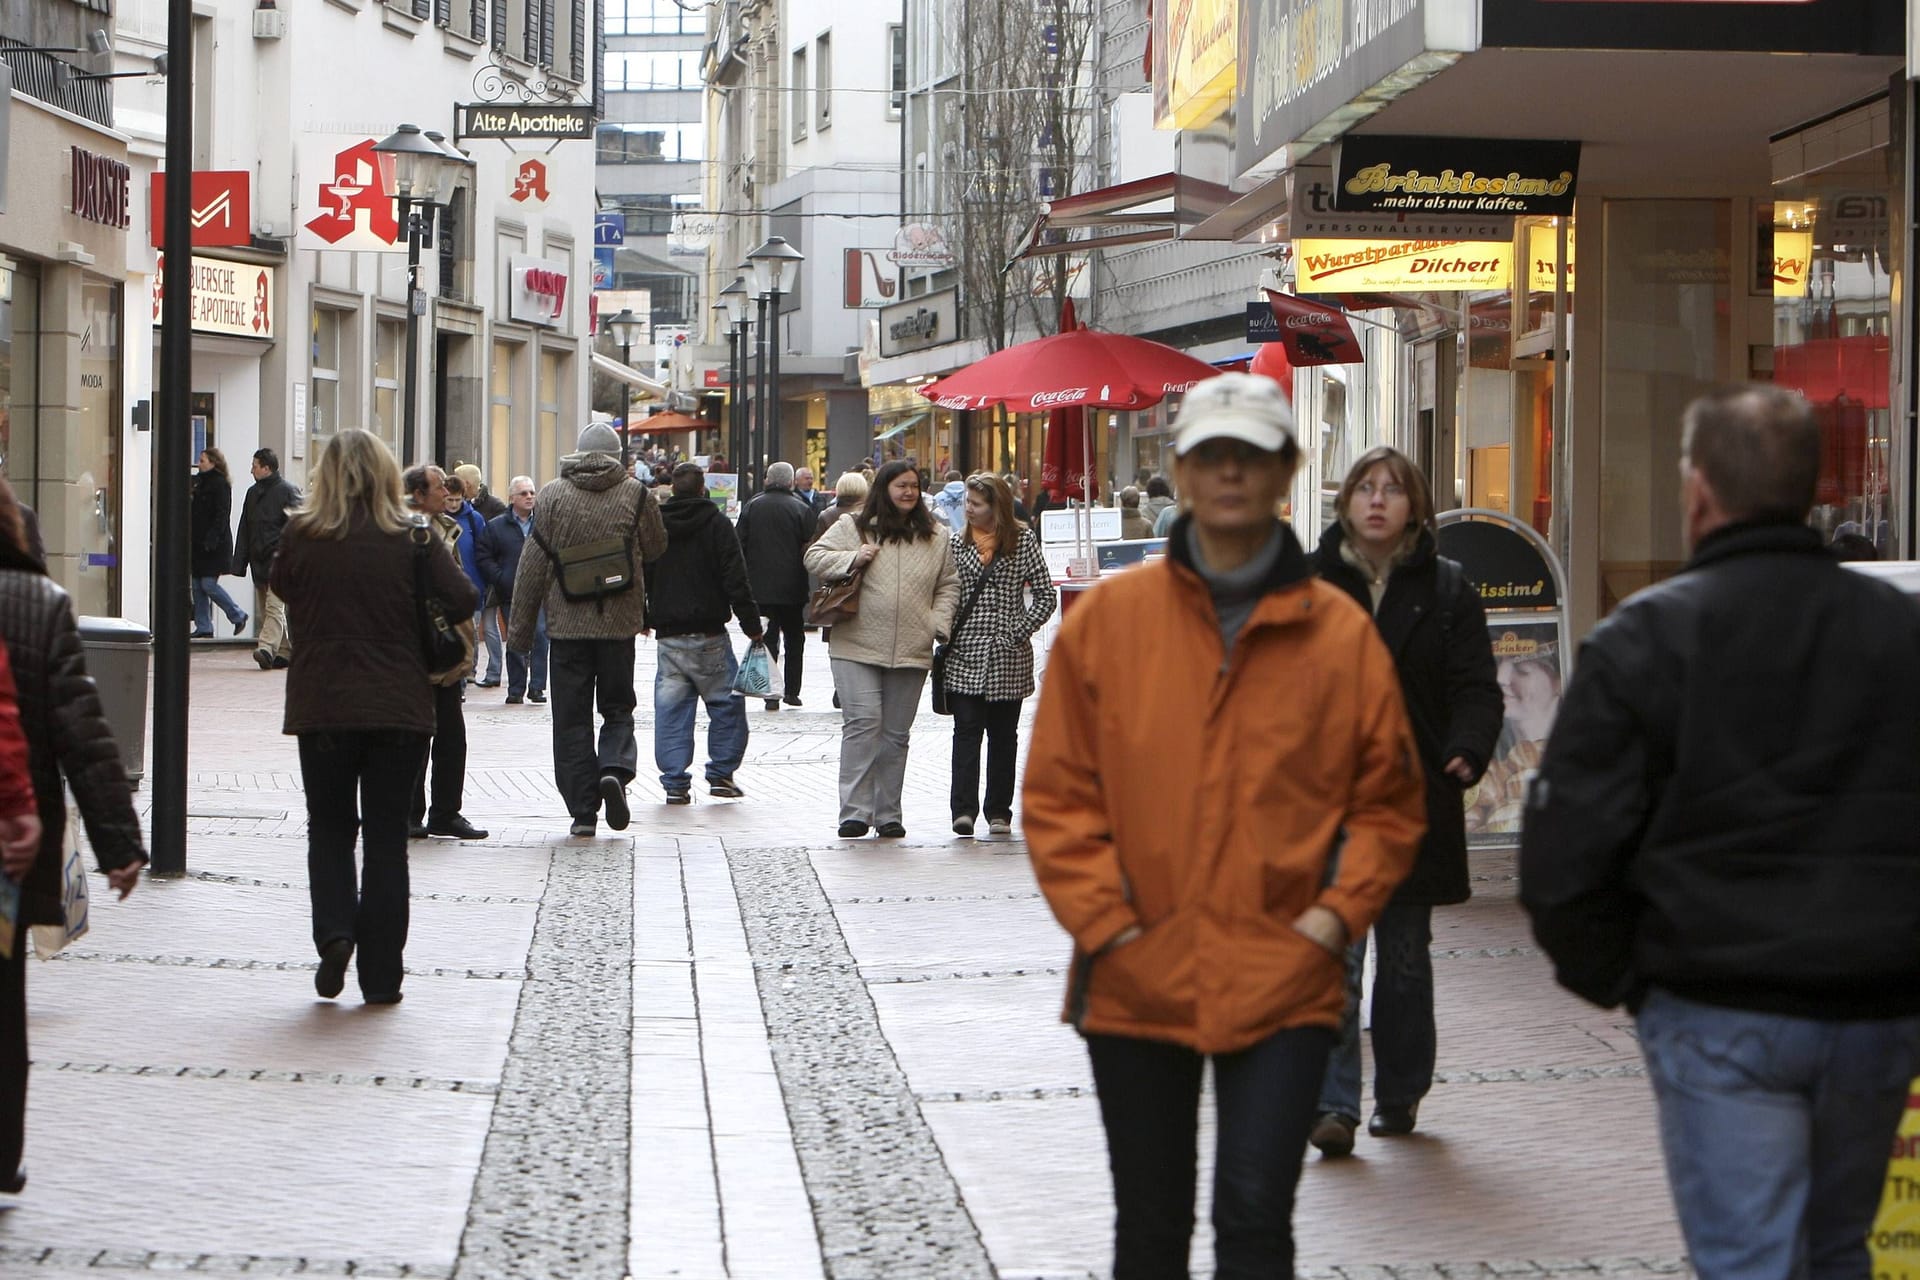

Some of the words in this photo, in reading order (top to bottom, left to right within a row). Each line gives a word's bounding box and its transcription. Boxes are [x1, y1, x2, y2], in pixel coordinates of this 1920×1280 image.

[508, 111, 584, 135] Apotheke
[71, 145, 131, 230] DROSTE
[1345, 162, 1573, 196] Brinkissimo
[1424, 196, 1445, 209] als
[1447, 198, 1475, 209] nur
[1476, 197, 1528, 211] Kaffee.
[1305, 223, 1499, 235] PERSONALSERVICE
[1409, 257, 1501, 274] Dilchert
[190, 264, 236, 296] BUERSCHE
[200, 296, 247, 327] APOTHEKE
[80, 374, 104, 389] MODA
